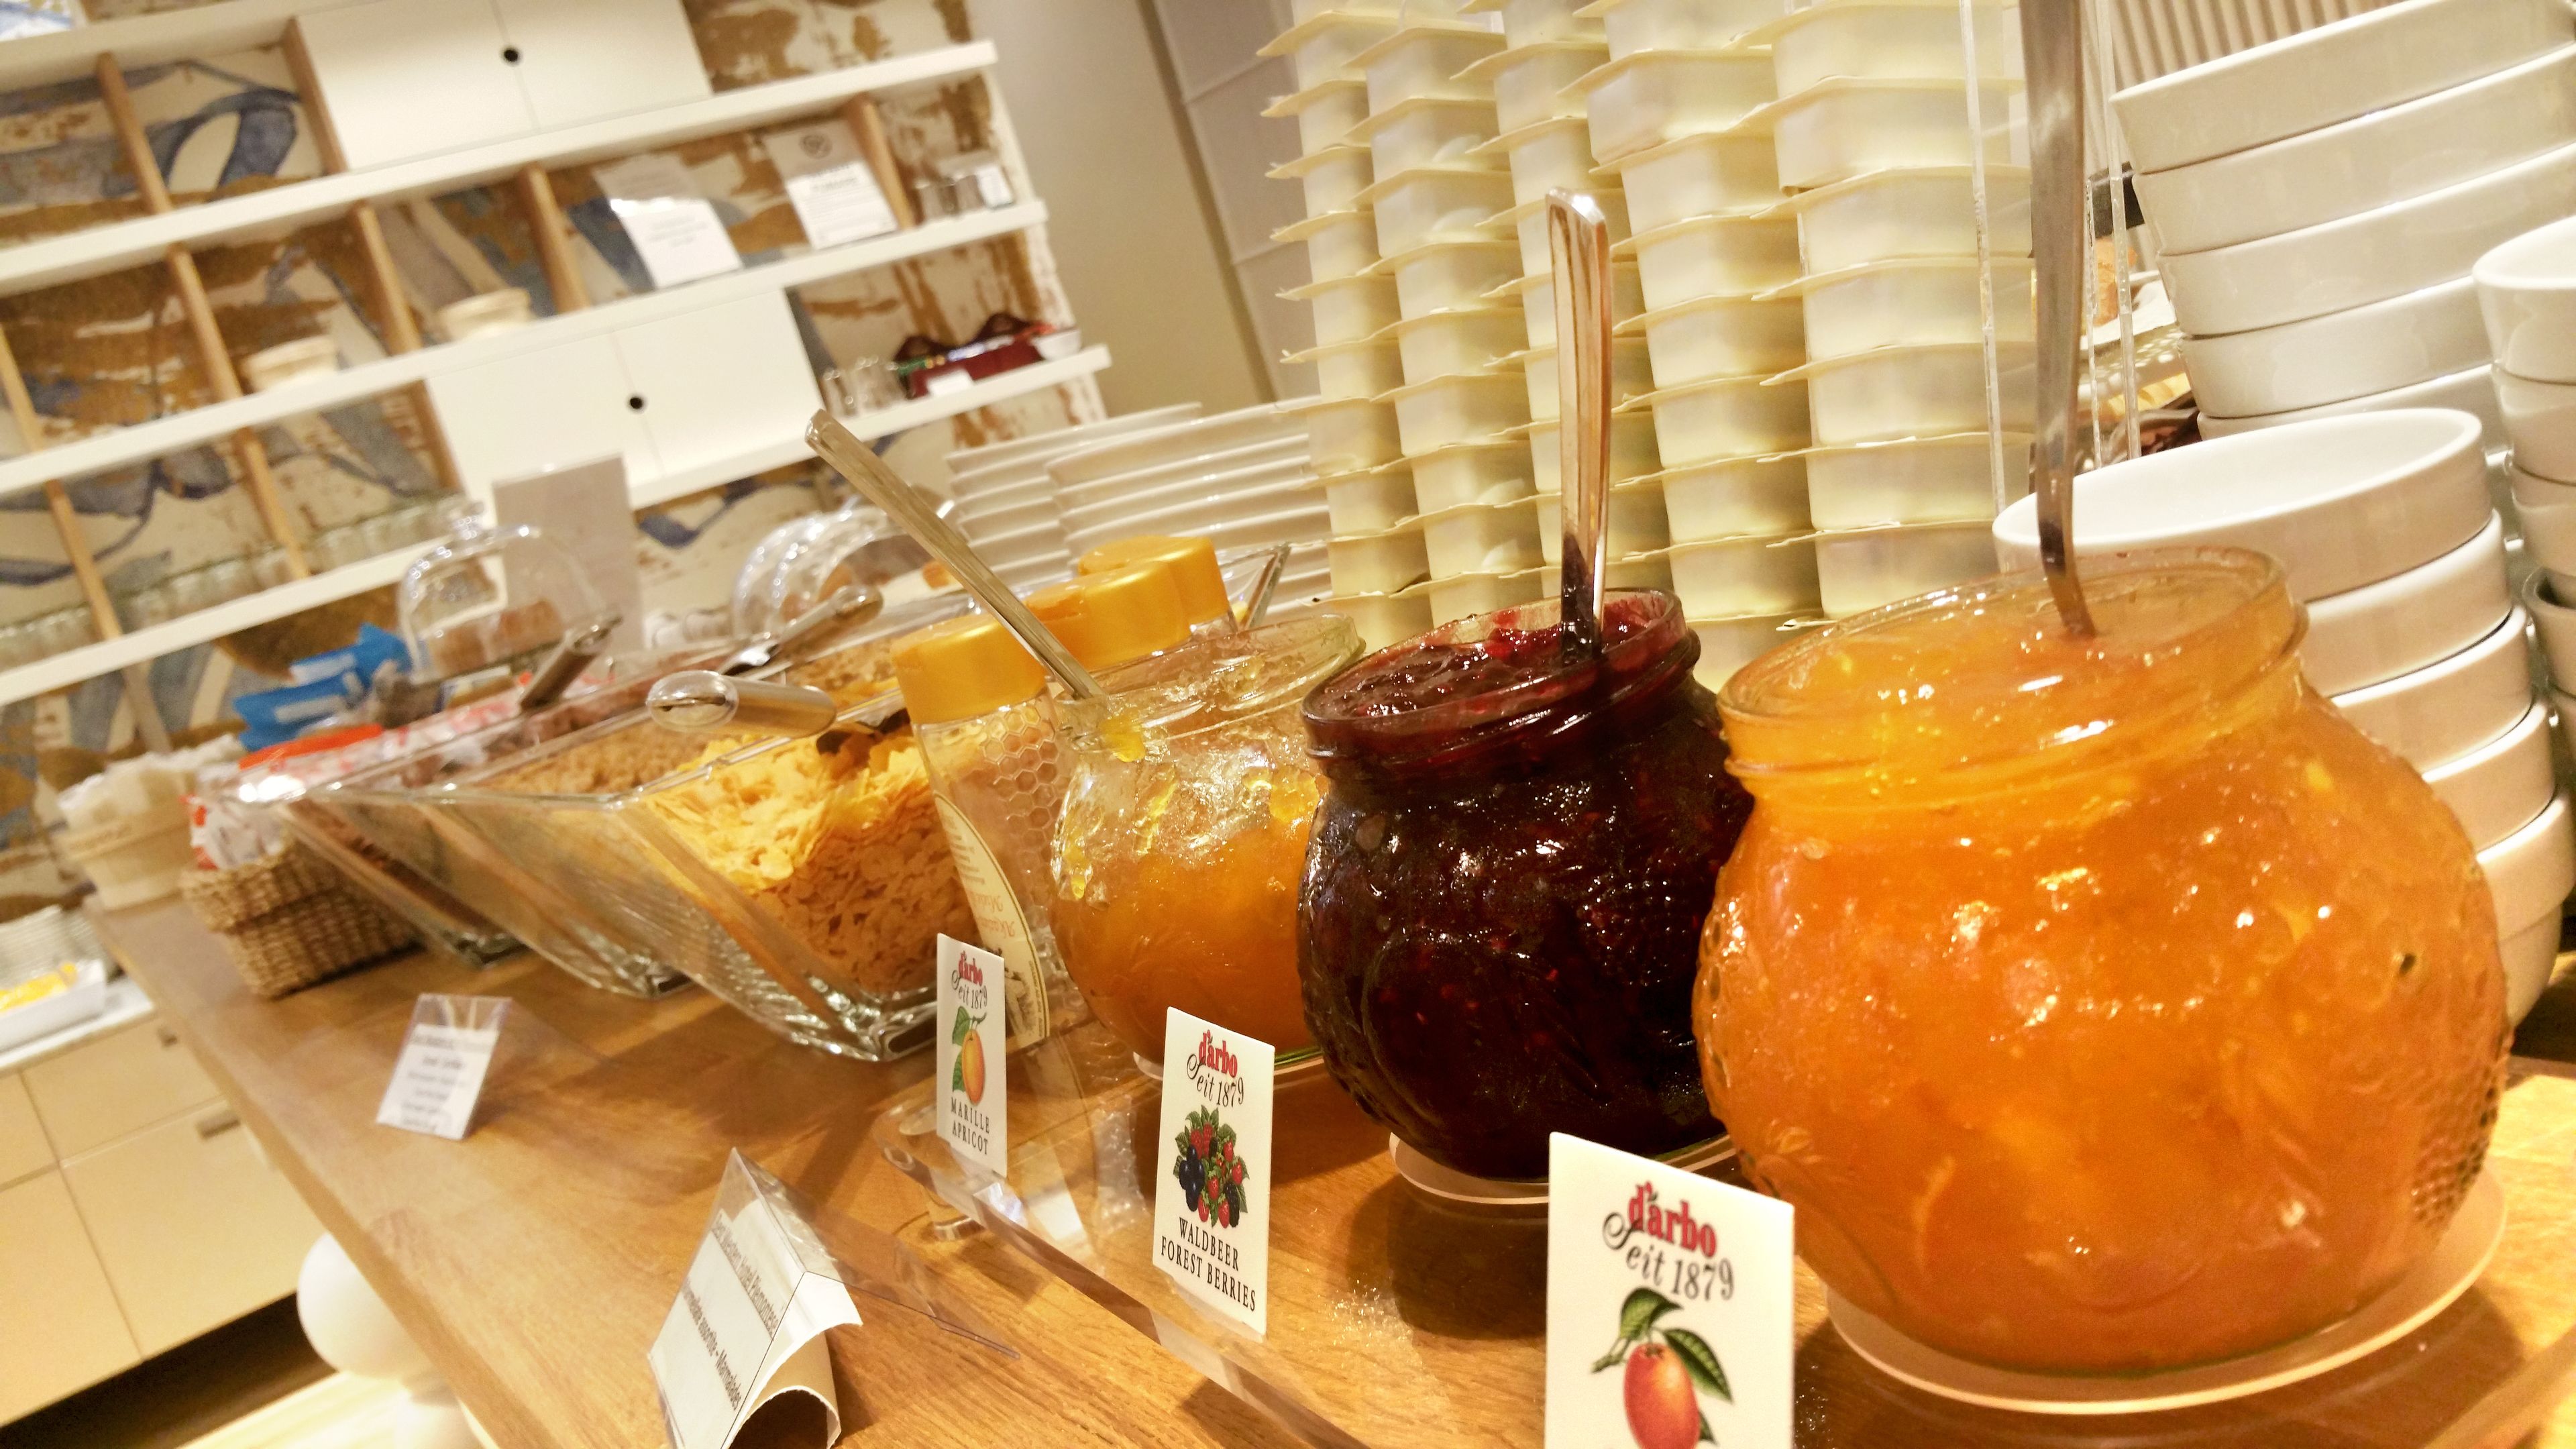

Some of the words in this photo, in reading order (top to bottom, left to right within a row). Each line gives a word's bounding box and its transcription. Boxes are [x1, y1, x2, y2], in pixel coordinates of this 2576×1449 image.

[951, 970, 969, 1006] Seit
[971, 985, 987, 1009] 1879
[1187, 1054, 1214, 1101] Seit
[1216, 1077, 1244, 1108] 1879
[951, 1097, 989, 1134] MARILLE
[953, 1120, 988, 1155] APRICOT
[1179, 1217, 1238, 1271] WALDBEER
[1602, 1212, 1664, 1286] Seit
[1671, 1258, 1735, 1301] 1879
[1161, 1236, 1203, 1278] FOREST
[1208, 1263, 1256, 1312] BERRIES
[749, 1275, 779, 1339] Piemontese
[715, 1349, 741, 1411] Marmalades
